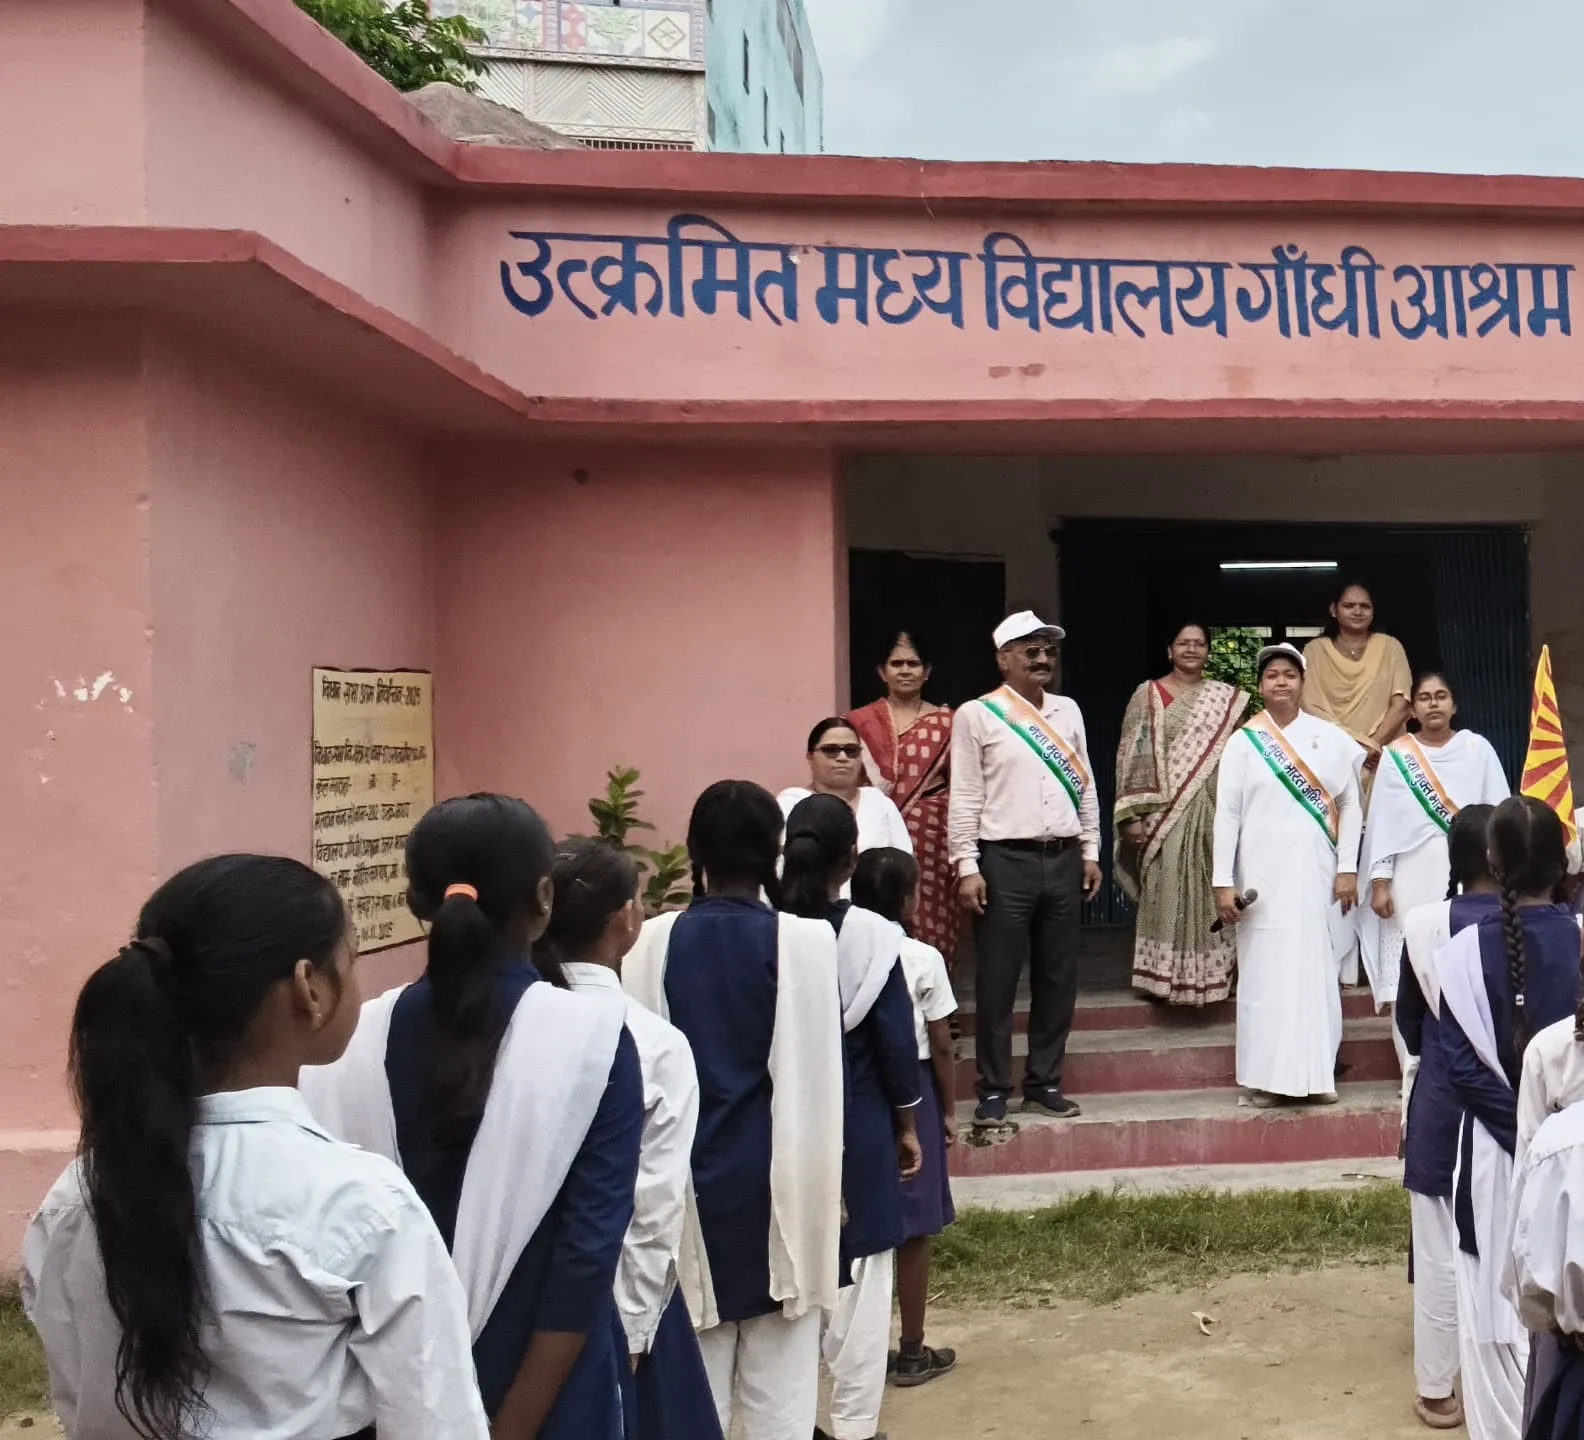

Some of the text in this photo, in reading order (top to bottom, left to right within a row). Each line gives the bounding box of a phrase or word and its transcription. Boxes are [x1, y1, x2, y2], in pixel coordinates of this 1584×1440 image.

[500, 213, 799, 325] उत्क्रमित
[814, 245, 972, 329] मध्य
[977, 232, 1230, 337] विद्यालय
[1236, 243, 1385, 339] गाँधी
[1284, 762, 1308, 788] भारत
